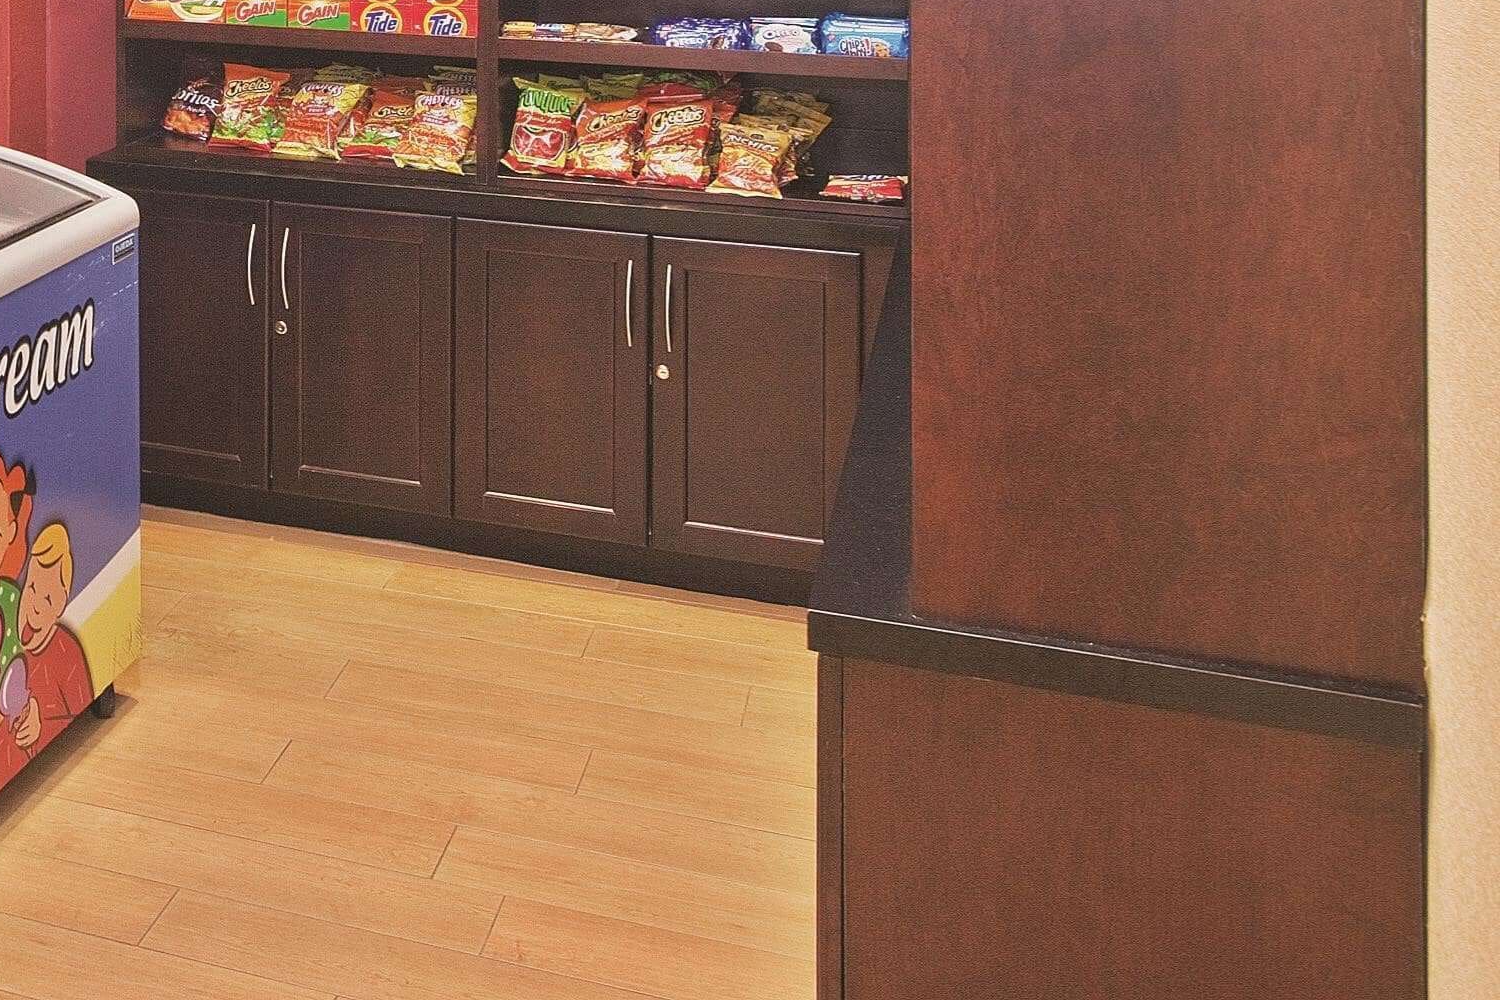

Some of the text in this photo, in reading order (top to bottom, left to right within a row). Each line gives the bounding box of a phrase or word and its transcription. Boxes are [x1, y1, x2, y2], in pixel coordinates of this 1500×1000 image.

[235, 2, 276, 21] GAIN
[297, 4, 339, 24] GAIN
[366, 11, 398, 33] Tide
[428, 14, 462, 36] Tide
[839, 39, 866, 53] Chips
[224, 78, 273, 97] Cheetos
[650, 107, 706, 133] Cheetos
